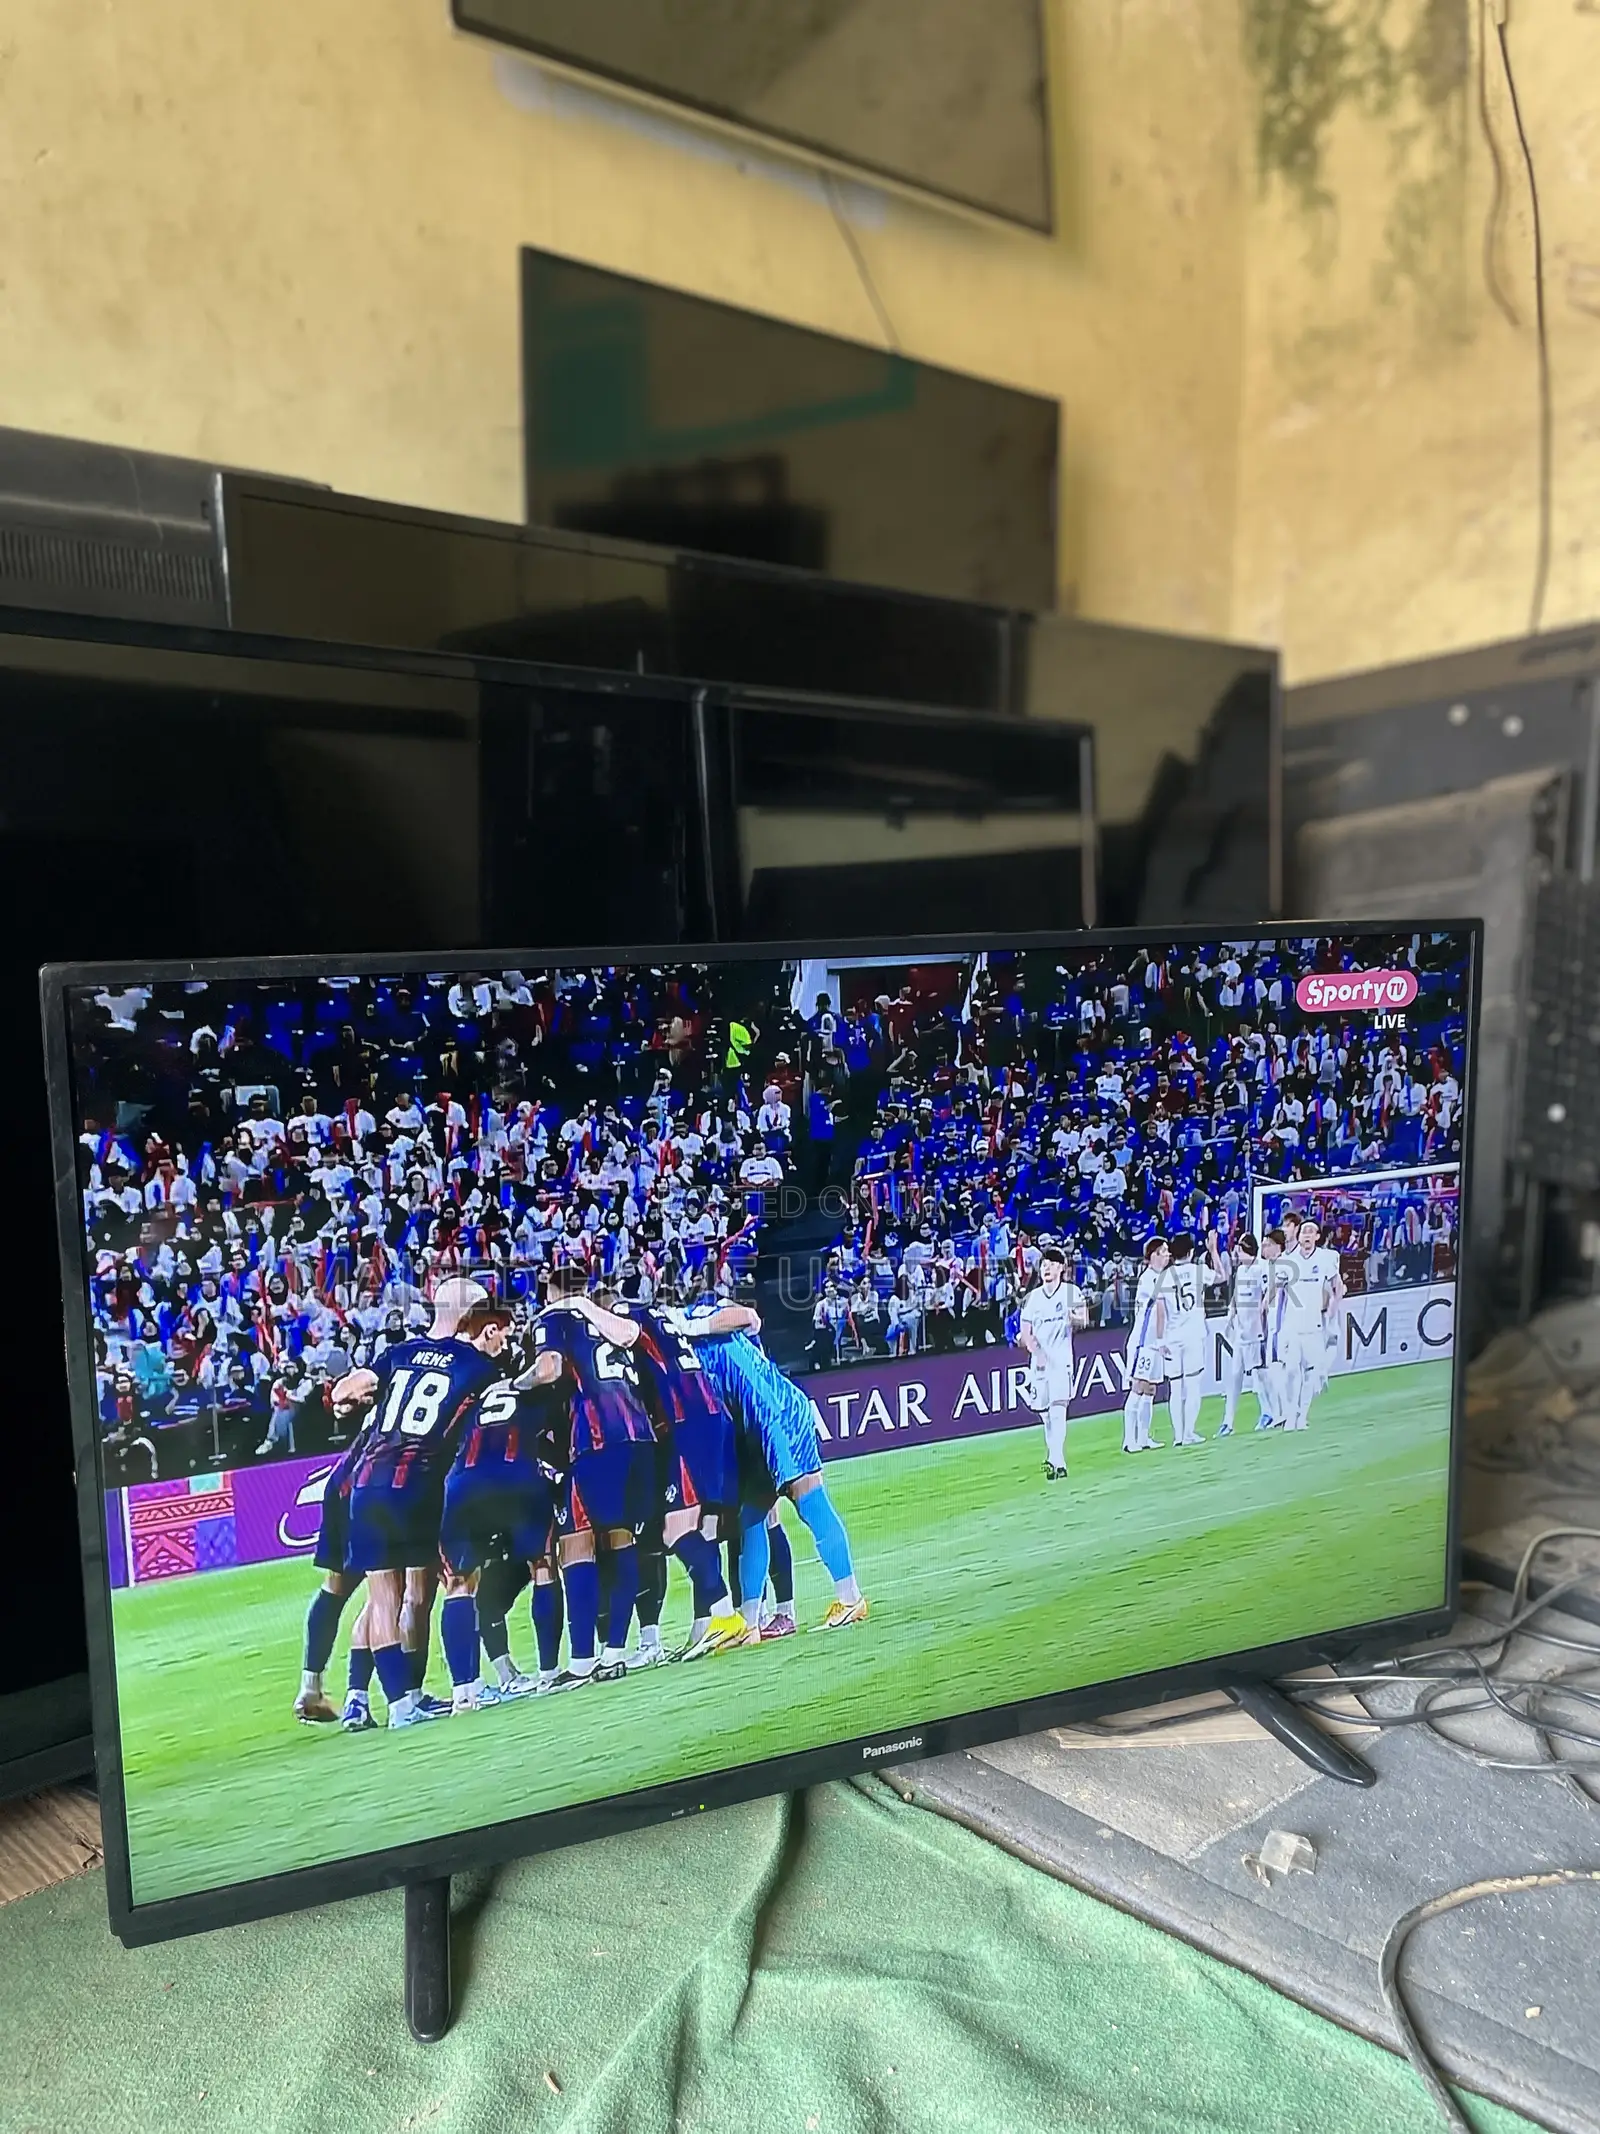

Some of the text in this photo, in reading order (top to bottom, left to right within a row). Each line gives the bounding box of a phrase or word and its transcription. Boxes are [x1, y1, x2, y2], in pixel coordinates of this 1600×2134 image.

[1306, 978, 1386, 1007] Sporty
[1374, 1013, 1406, 1030] LIVE
[1172, 1281, 1195, 1312] 15
[380, 1368, 450, 1437] 18
[862, 1736, 923, 1759] Panasonic
